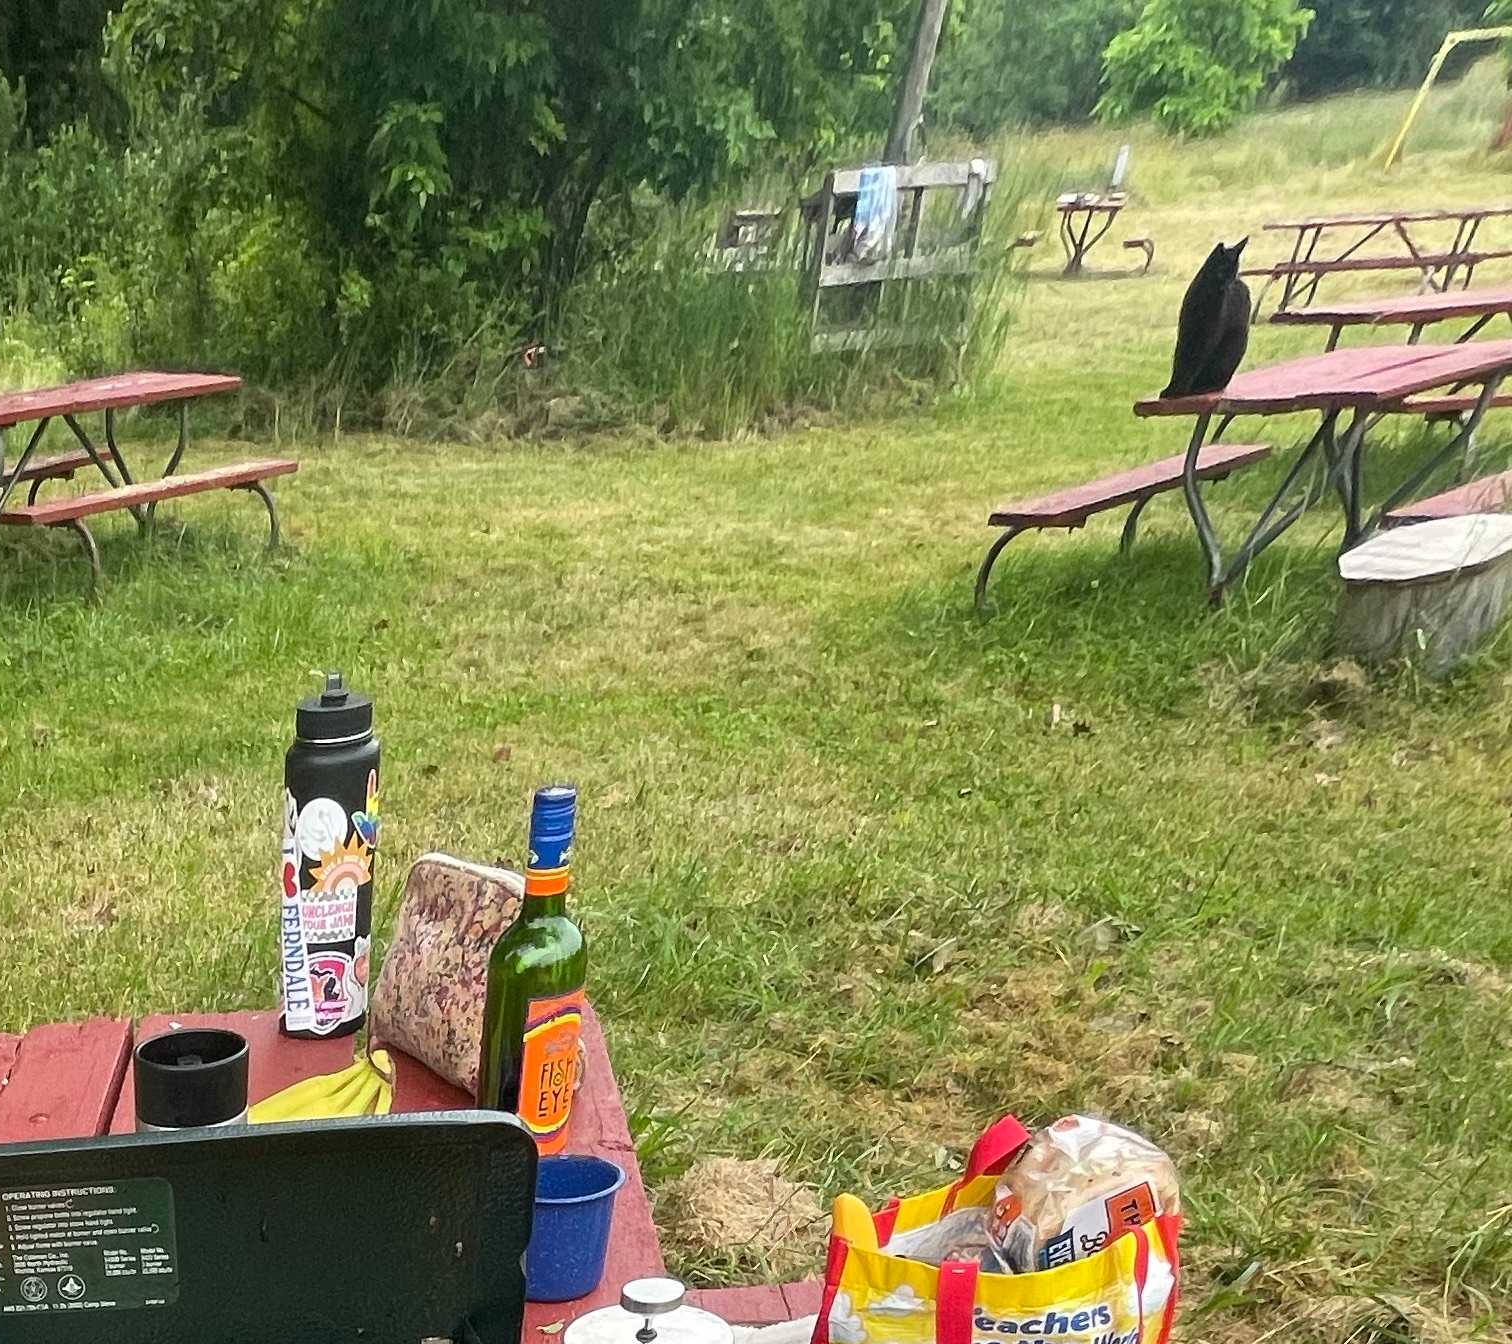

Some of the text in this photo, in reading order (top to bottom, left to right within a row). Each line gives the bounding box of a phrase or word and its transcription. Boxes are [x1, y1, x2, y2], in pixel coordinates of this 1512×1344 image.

[283, 903, 311, 1012] FERNDALE
[540, 1057, 575, 1089] FISH
[974, 1305, 1111, 1334] eachers
